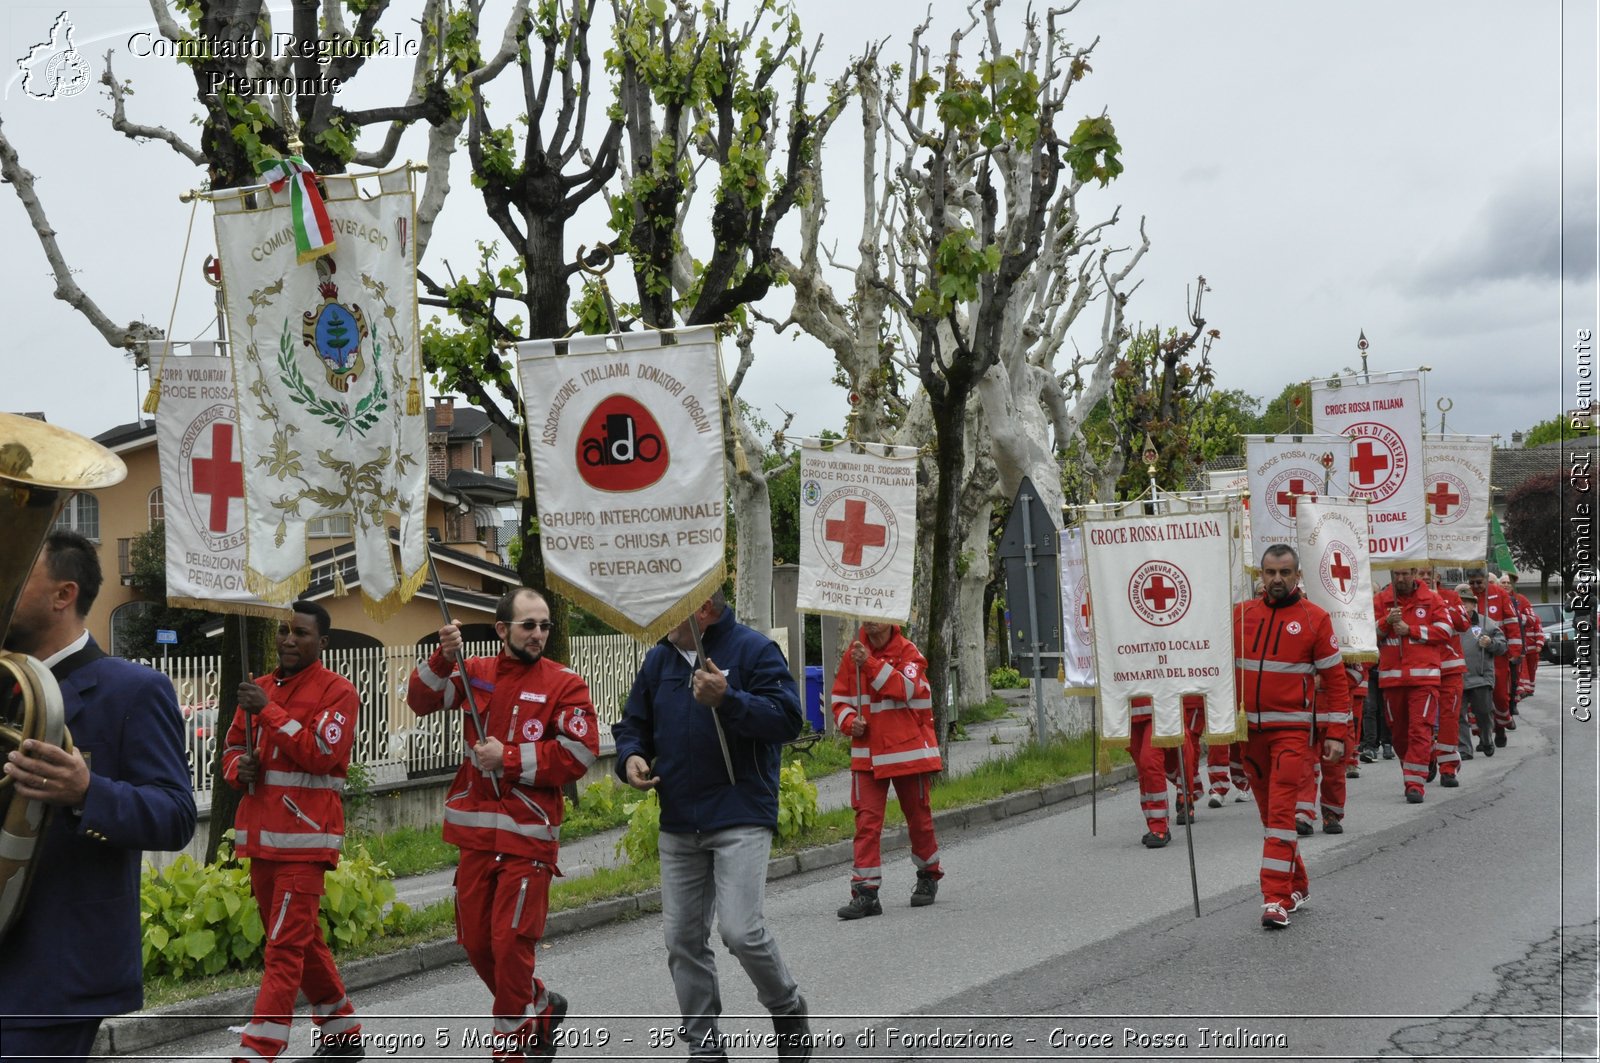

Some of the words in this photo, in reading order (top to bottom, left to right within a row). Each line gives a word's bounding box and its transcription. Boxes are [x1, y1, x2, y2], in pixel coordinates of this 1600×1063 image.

[251, 226, 295, 262] COMUN
[541, 378, 581, 447] ASSOCIAZIONE
[580, 363, 630, 386] ITALIANA
[637, 363, 686, 397] DONATORI
[681, 394, 712, 435] ORGANI
[1324, 402, 1347, 416] CROCE
[1348, 401, 1371, 413] ROSSA
[1372, 397, 1404, 412] ITALIANA
[582, 415, 662, 467] aido
[1372, 427, 1382, 437] DI
[1383, 431, 1405, 469] GINEVRA
[863, 464, 876, 474] DEL
[877, 465, 911, 476] SOCCORSO
[1257, 456, 1280, 477] CROCE
[1280, 450, 1307, 461] ROSSA
[801, 469, 834, 481] CROCE
[836, 472, 869, 484] ROSSA
[872, 476, 915, 487] ITALIANA
[1379, 481, 1397, 498] 1864
[600, 502, 722, 525] INTERCOMUNALE
[816, 487, 858, 519] CONVENZIONE
[861, 489, 871, 498] DI
[871, 495, 897, 527] GINEVRA
[1375, 512, 1407, 523] LOCALE
[546, 535, 595, 551] BOVES
[614, 532, 671, 550] CHIUSA
[676, 527, 723, 546] PESIO
[1090, 527, 1128, 546] CROCE
[1129, 524, 1165, 543] ROSSA
[1166, 520, 1221, 541] ITALIANA
[1368, 536, 1410, 554] DOVI'
[589, 558, 682, 577] PEVERAGNO
[1138, 571, 1146, 580] DI
[1144, 564, 1172, 575] GINEVRA
[1171, 571, 1181, 581] 22
[816, 579, 850, 592] COMITATO
[858, 586, 896, 598] LOCALE
[1177, 580, 1188, 608] AGOSTO
[821, 590, 883, 609] MORETTA
[1132, 580, 1155, 621] CONVENZIONE
[1167, 607, 1182, 620] 1864
[1117, 641, 1167, 655] COMITATO
[1168, 639, 1210, 651] LOCALE
[1158, 654, 1168, 665] DI
[1113, 668, 1165, 682] SOMMARIVA
[1166, 667, 1186, 679] DEL
[1188, 666, 1220, 678] BOSCO
